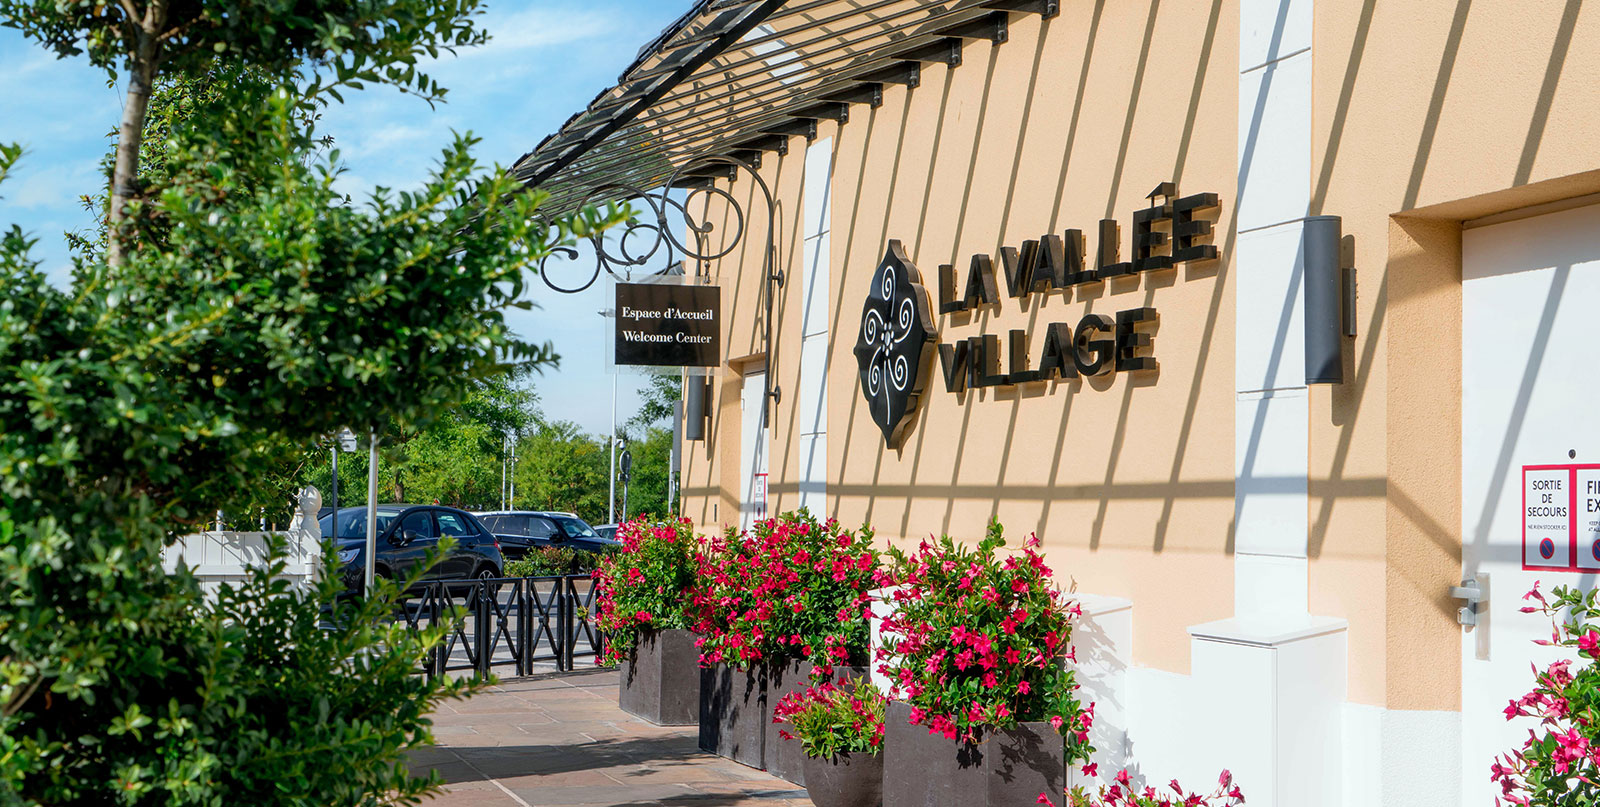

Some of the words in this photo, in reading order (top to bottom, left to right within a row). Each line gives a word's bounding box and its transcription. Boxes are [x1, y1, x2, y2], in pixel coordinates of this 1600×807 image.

[938, 254, 1000, 315] LA
[1001, 182, 1219, 298] VALLÉE
[622, 306, 661, 321] Espace
[664, 308, 713, 320] d'Accueil
[623, 330, 673, 343] Welcome
[676, 332, 712, 343] Center
[938, 307, 1157, 393] VILLAGE
[1532, 480, 1562, 490] SORTIE
[1542, 494, 1552, 504] DE
[1527, 507, 1567, 517] SECOURS
